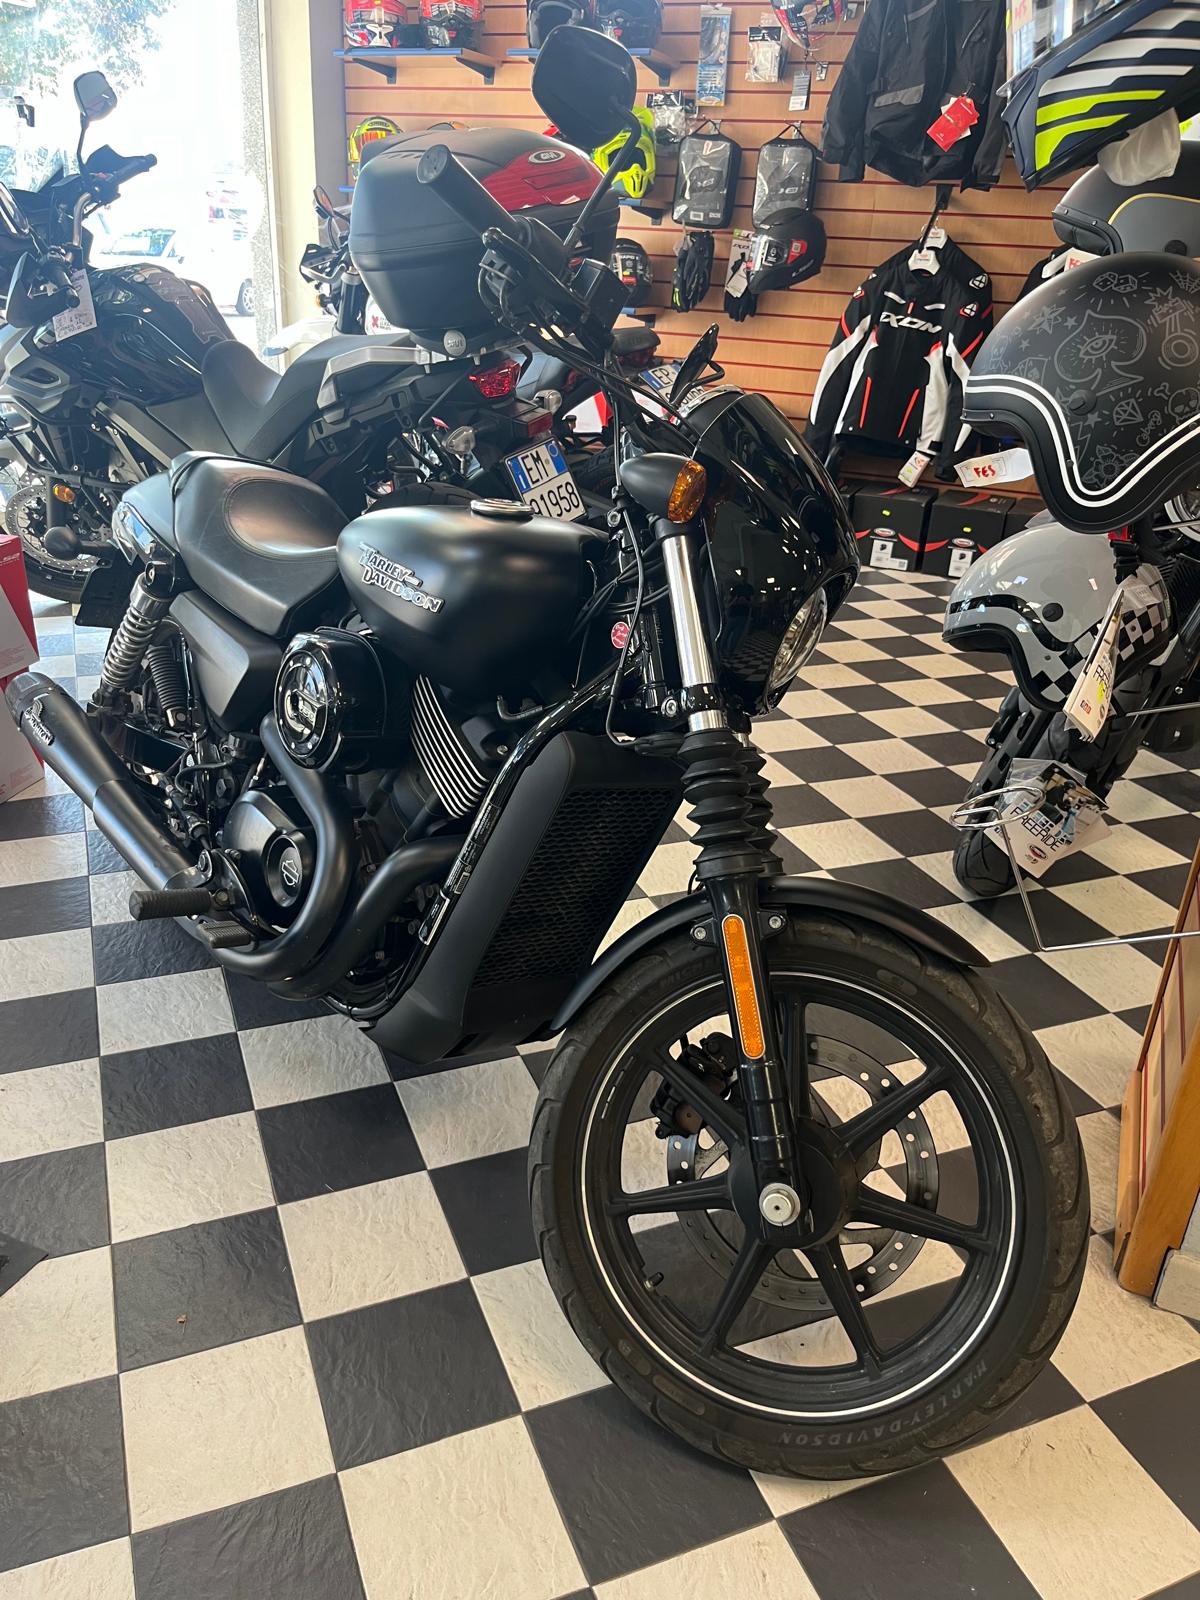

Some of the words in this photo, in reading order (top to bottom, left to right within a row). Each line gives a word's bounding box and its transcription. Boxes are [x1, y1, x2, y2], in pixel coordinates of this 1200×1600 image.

[880, 311, 942, 334] IXON
[651, 367, 674, 385] EP
[520, 449, 549, 485] EM
[529, 481, 580, 518] 91958
[362, 565, 445, 613] DAVIDSON
